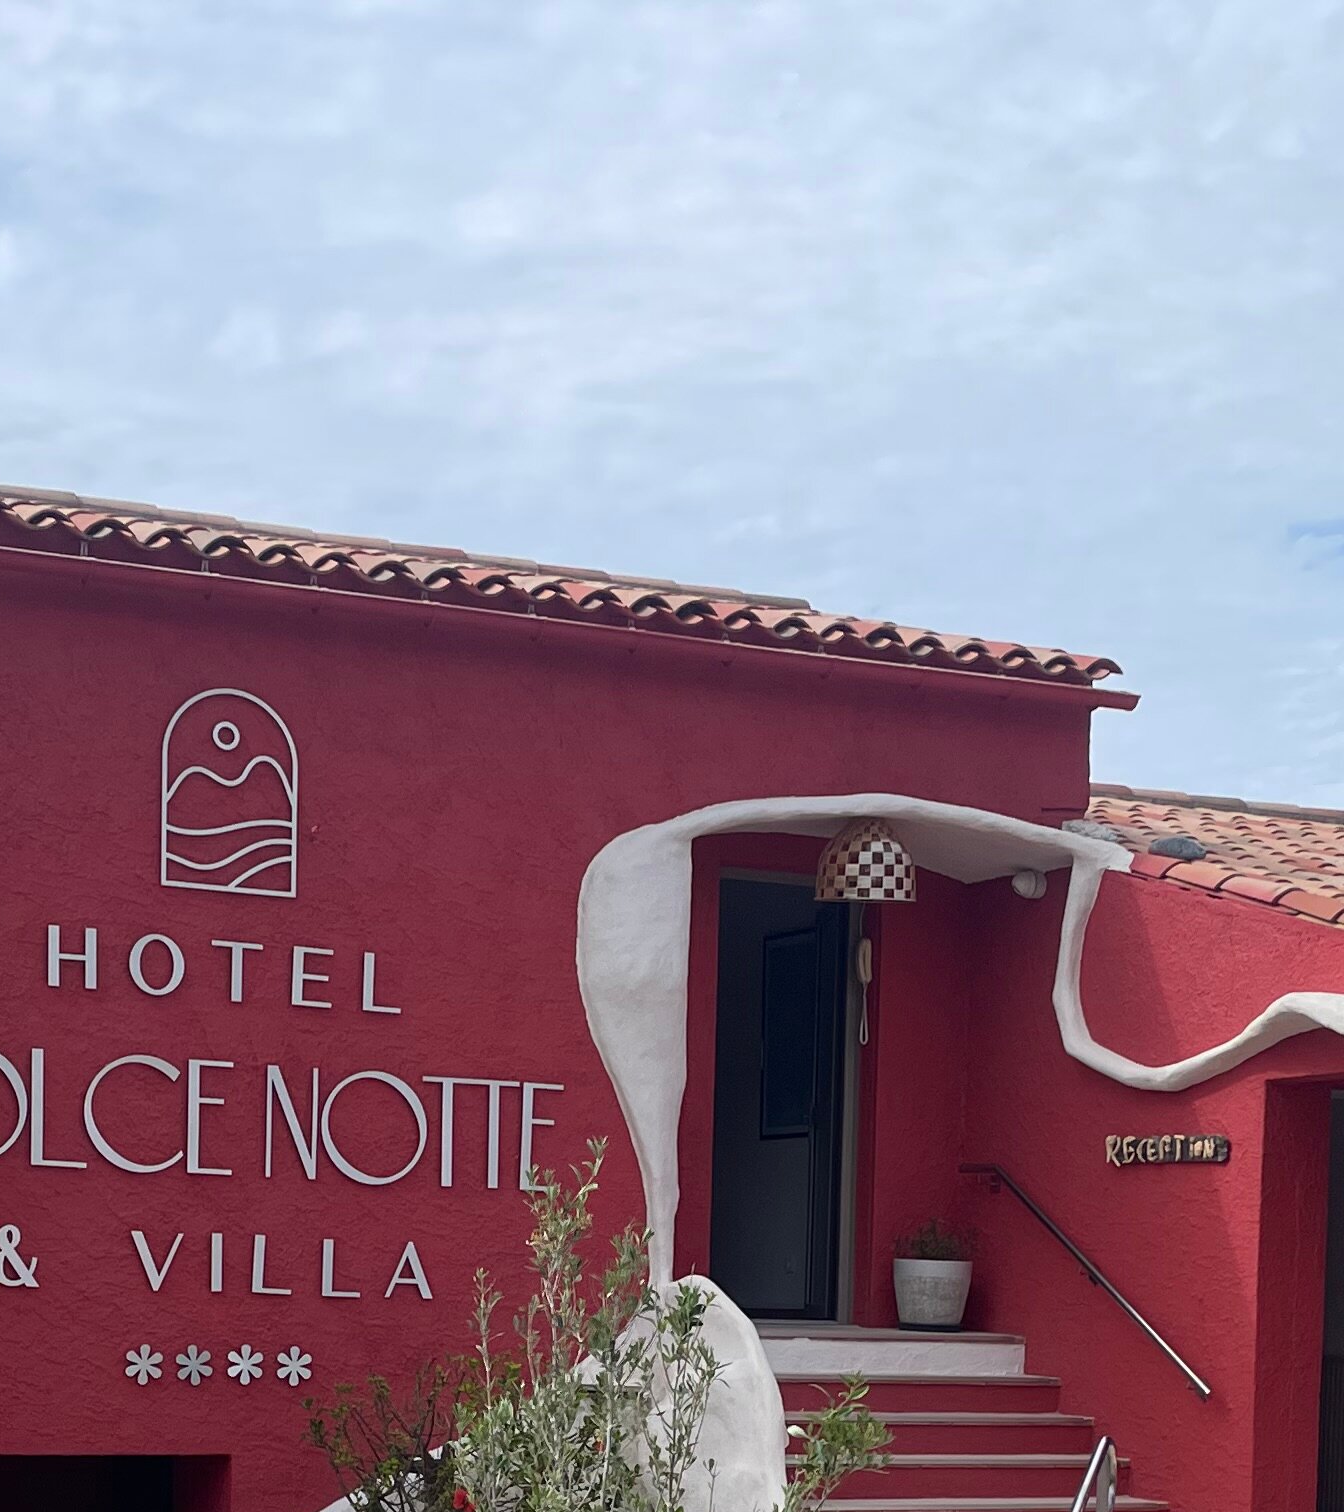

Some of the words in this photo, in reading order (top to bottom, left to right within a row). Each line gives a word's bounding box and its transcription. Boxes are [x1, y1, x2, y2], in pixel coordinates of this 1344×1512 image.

[47, 924, 402, 1014] HOTEL
[265, 1064, 564, 1192] NOTTE
[131, 1230, 433, 1299] VILLA
